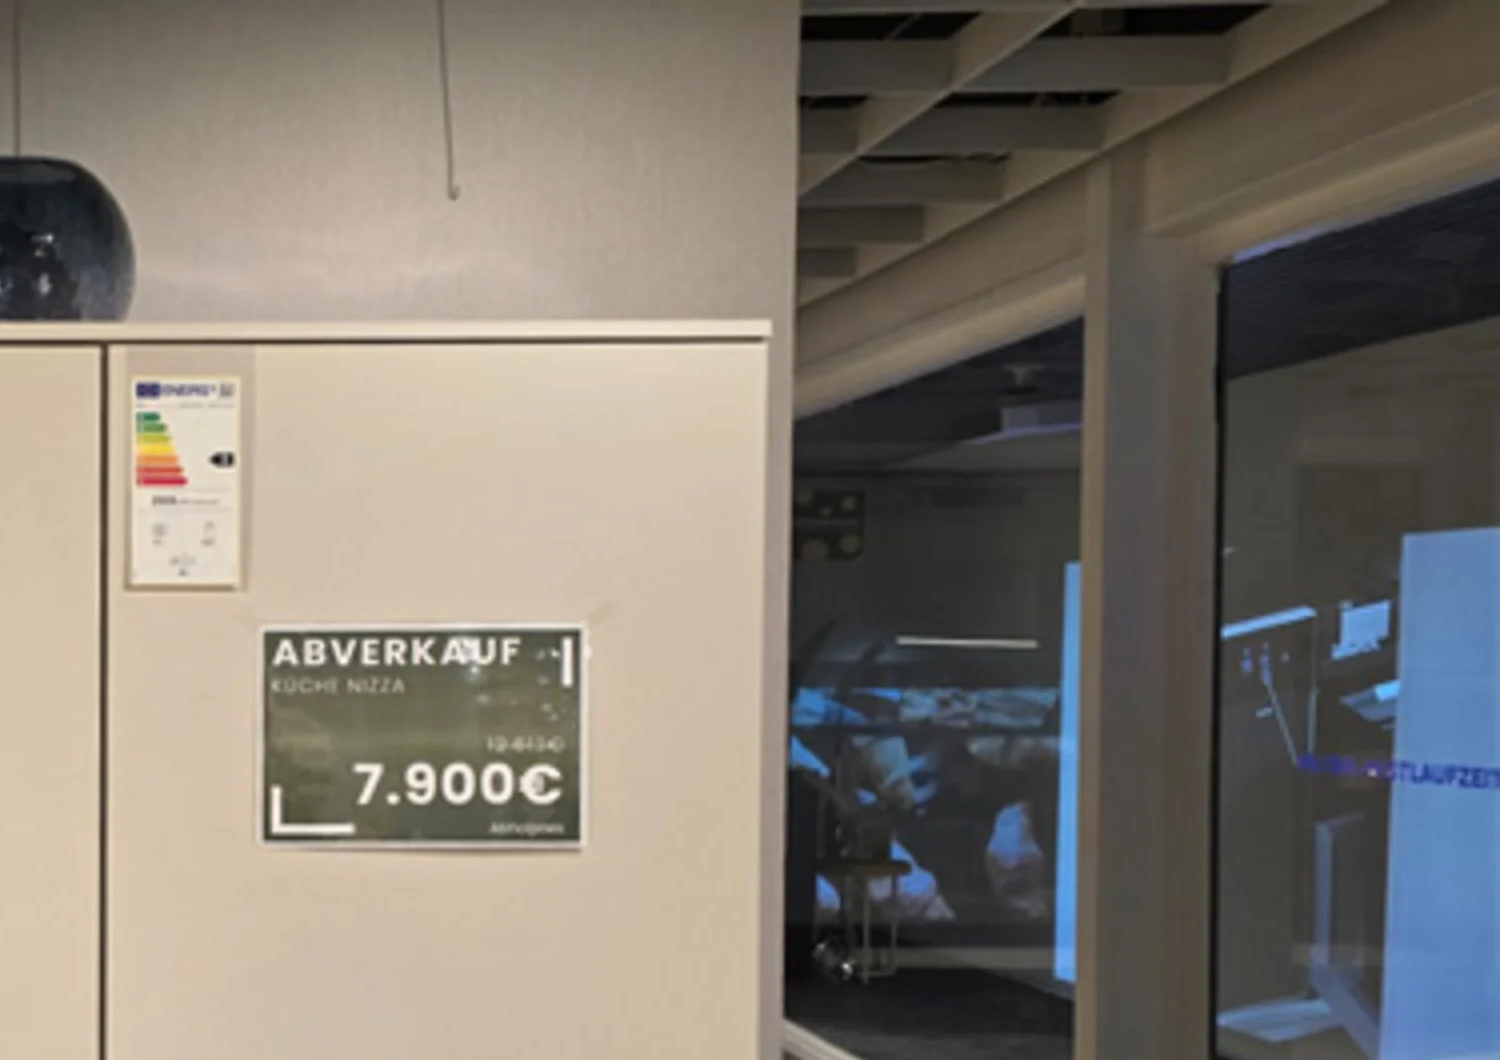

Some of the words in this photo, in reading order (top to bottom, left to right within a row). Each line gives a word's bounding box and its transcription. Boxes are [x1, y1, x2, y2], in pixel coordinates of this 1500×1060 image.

[272, 637, 522, 667] ABVERKAUF
[346, 677, 406, 695] NIZZA
[352, 761, 563, 806] 7.900€
